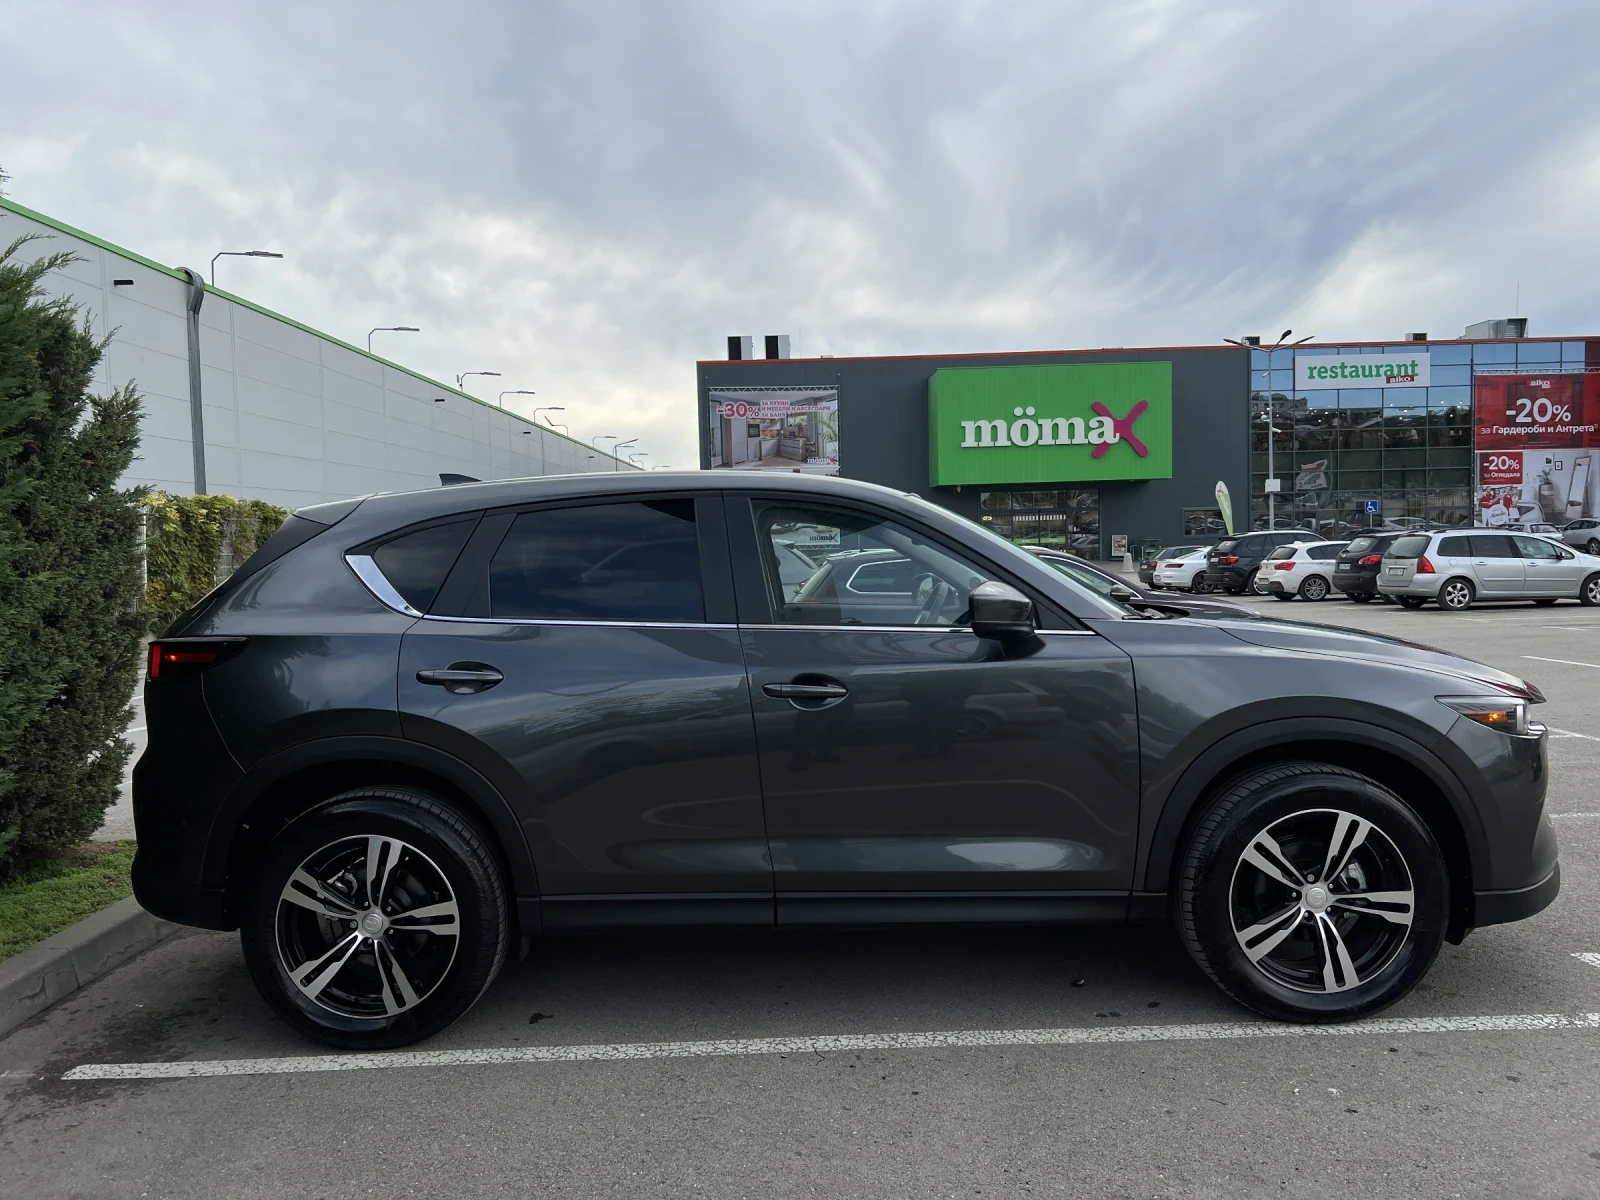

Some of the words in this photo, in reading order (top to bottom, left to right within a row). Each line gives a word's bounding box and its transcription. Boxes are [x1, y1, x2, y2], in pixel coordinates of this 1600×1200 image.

[1308, 360, 1418, 379] restaurant
[717, 402, 760, 418] -30%
[1506, 397, 1572, 423] -20%
[1492, 424, 1546, 436] Гардероби
[1483, 455, 1520, 470] -20%
